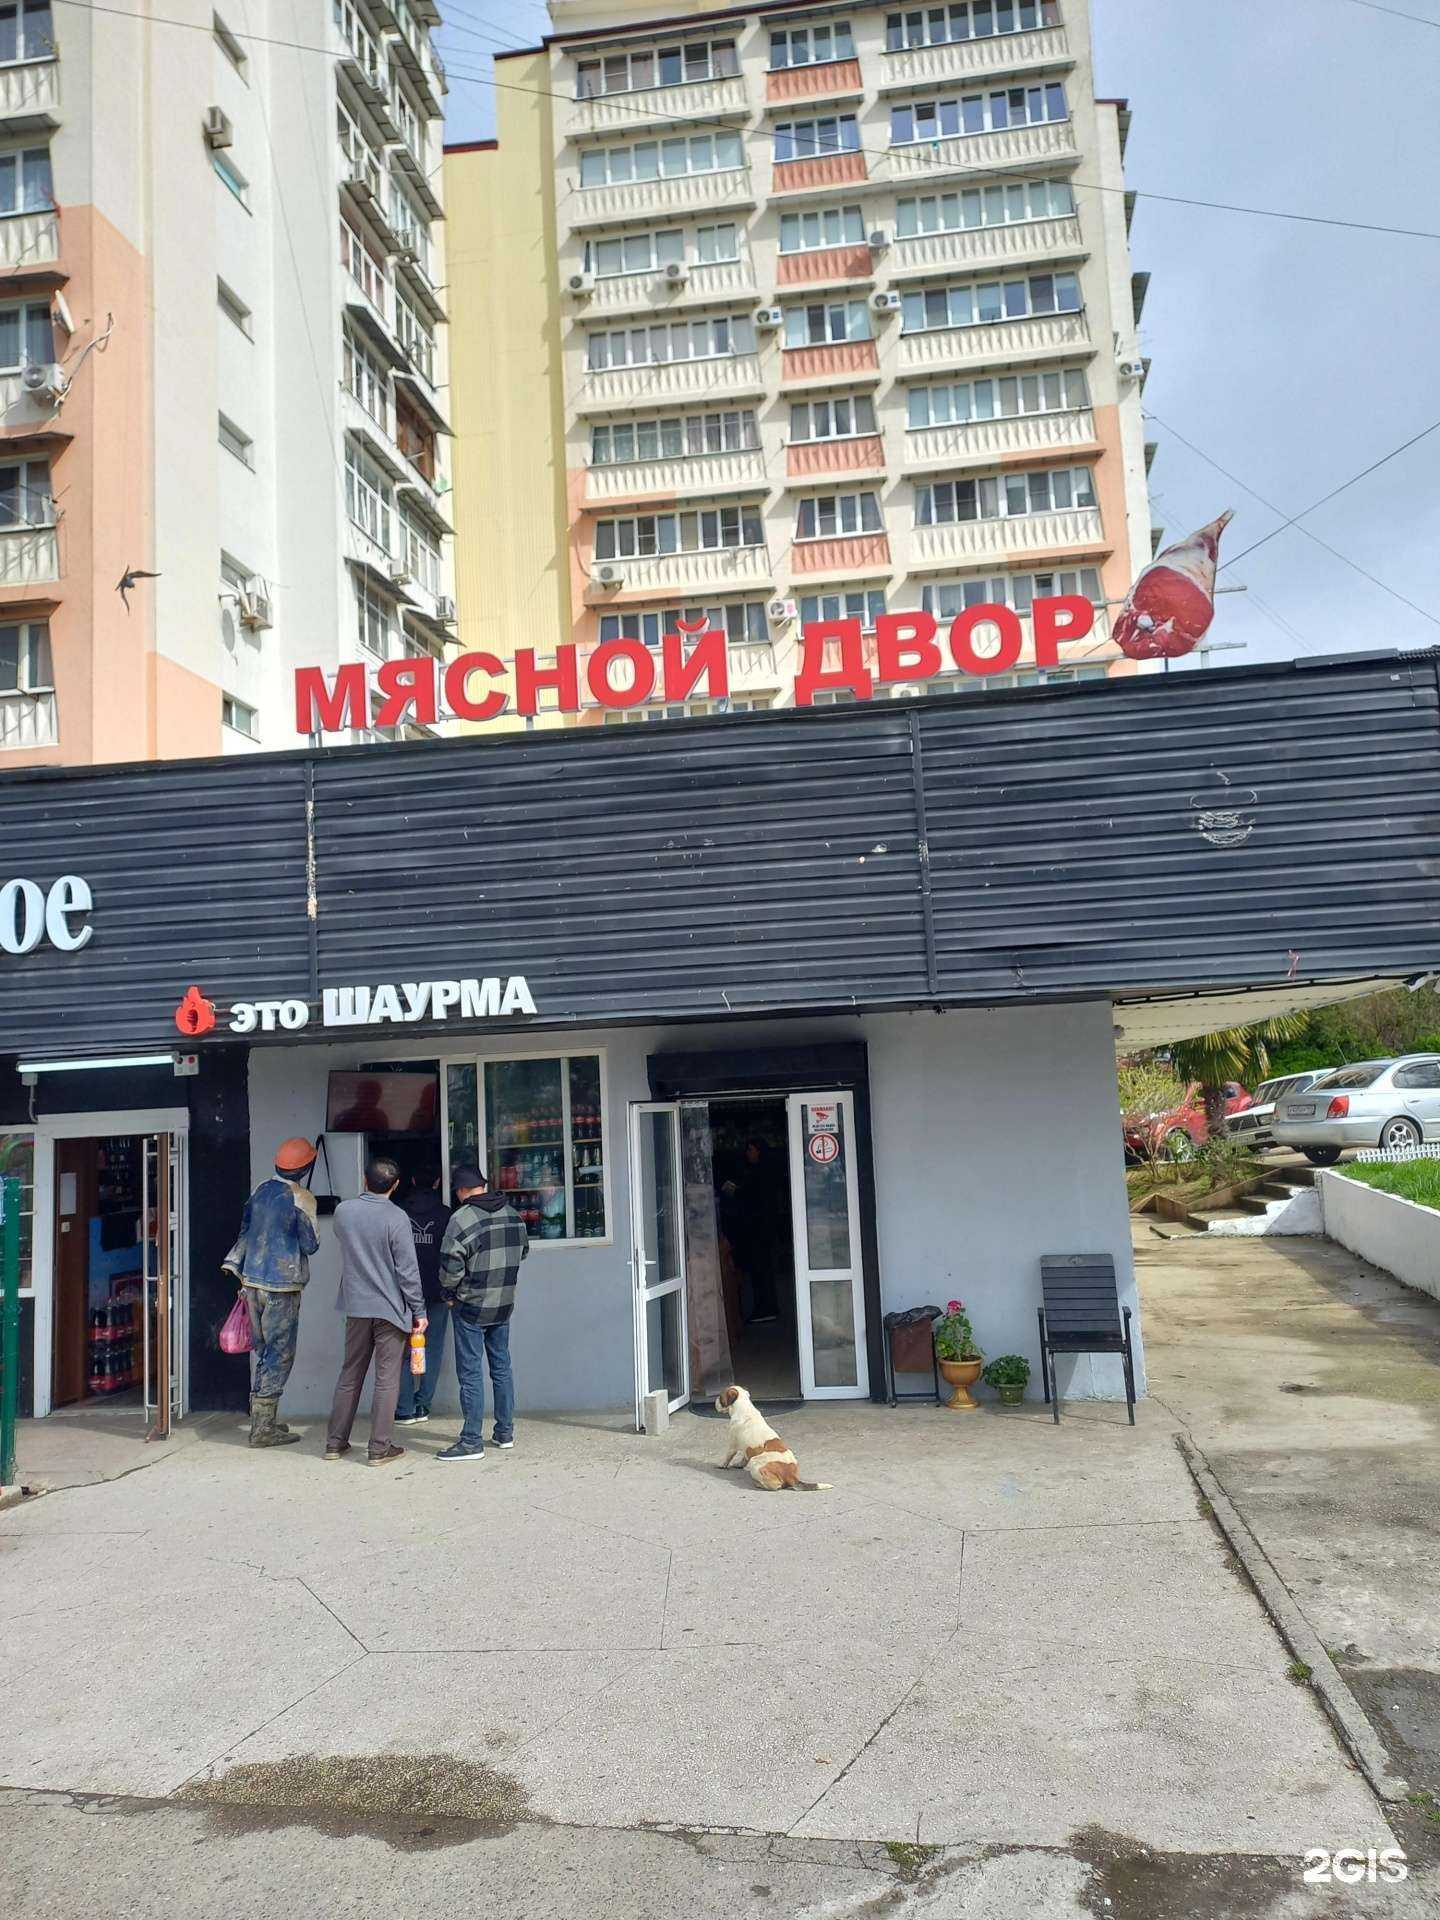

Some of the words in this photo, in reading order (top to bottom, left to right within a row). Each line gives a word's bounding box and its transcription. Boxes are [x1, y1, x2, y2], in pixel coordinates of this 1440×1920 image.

[295, 616, 729, 734] МЯСНОЙ
[794, 594, 1095, 706] ДВОР
[323, 976, 538, 1027] ШАУРМА
